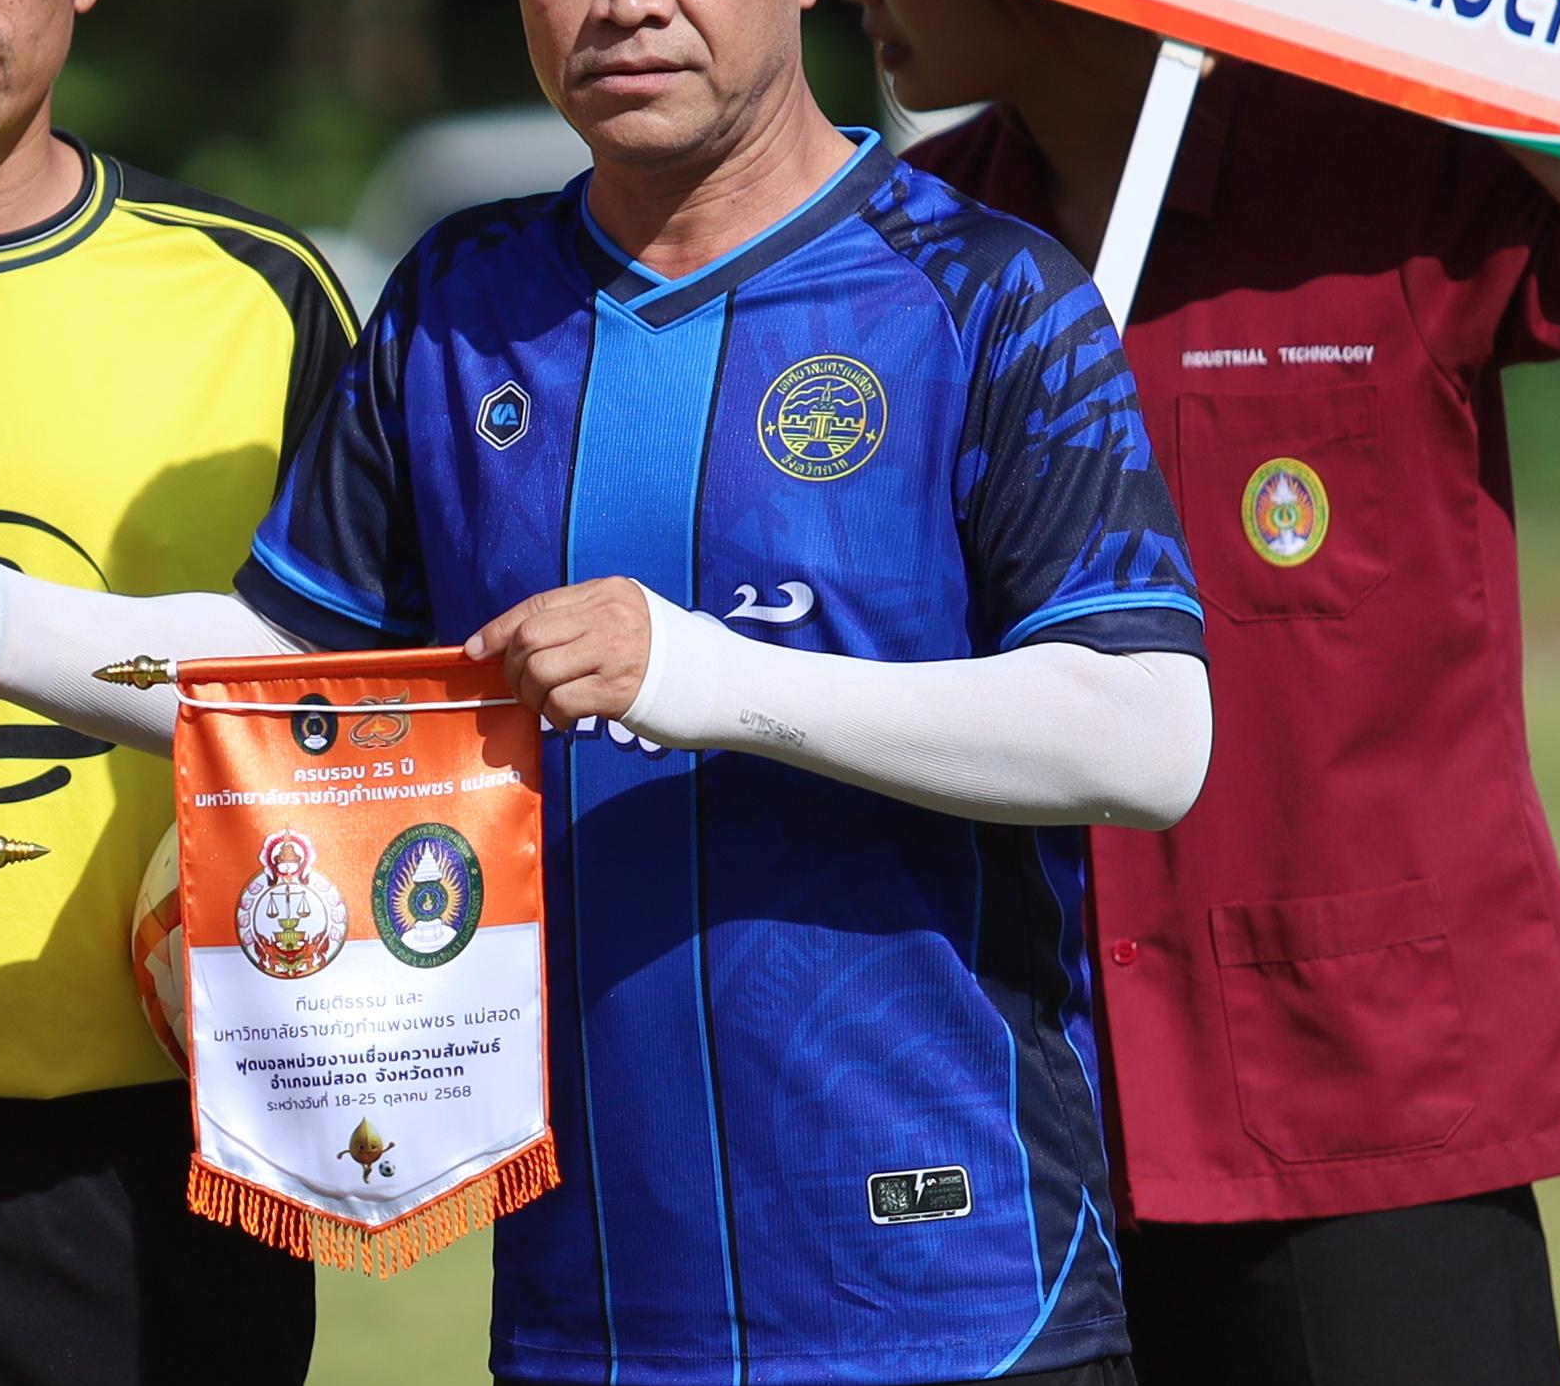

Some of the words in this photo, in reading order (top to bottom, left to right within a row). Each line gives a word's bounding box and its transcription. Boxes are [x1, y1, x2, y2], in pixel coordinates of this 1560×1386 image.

[1278, 344, 1375, 365] TECHNOLOGY
[293, 765, 366, 783] ครบรอบ
[372, 762, 394, 779] 25
[400, 757, 415, 776] ปี
[194, 781, 454, 808] มหาวิทยาลัยราชภัฏกำแพงเพชร
[460, 768, 521, 792] แม่สอด
[295, 995, 387, 1014] ทีมยุติธรรม
[395, 991, 423, 1006] และ
[213, 1012, 456, 1043] มหาวิทยาลัยราชภัฏกำแพงเพชร
[463, 1006, 521, 1026] แม่สอด
[235, 1038, 502, 1077] ฟุตบอลหน่วยงานเชื่อมความสัมพันธ์
[270, 1069, 368, 1090] อำเภอแม่สอด
[375, 1063, 465, 1085] จังหวัดตาก
[266, 1090, 330, 1112] ระหว่างวันที่
[334, 1092, 377, 1108] 18-25
[382, 1089, 429, 1108] ตุลาคม
[433, 1084, 472, 1101] 2568
